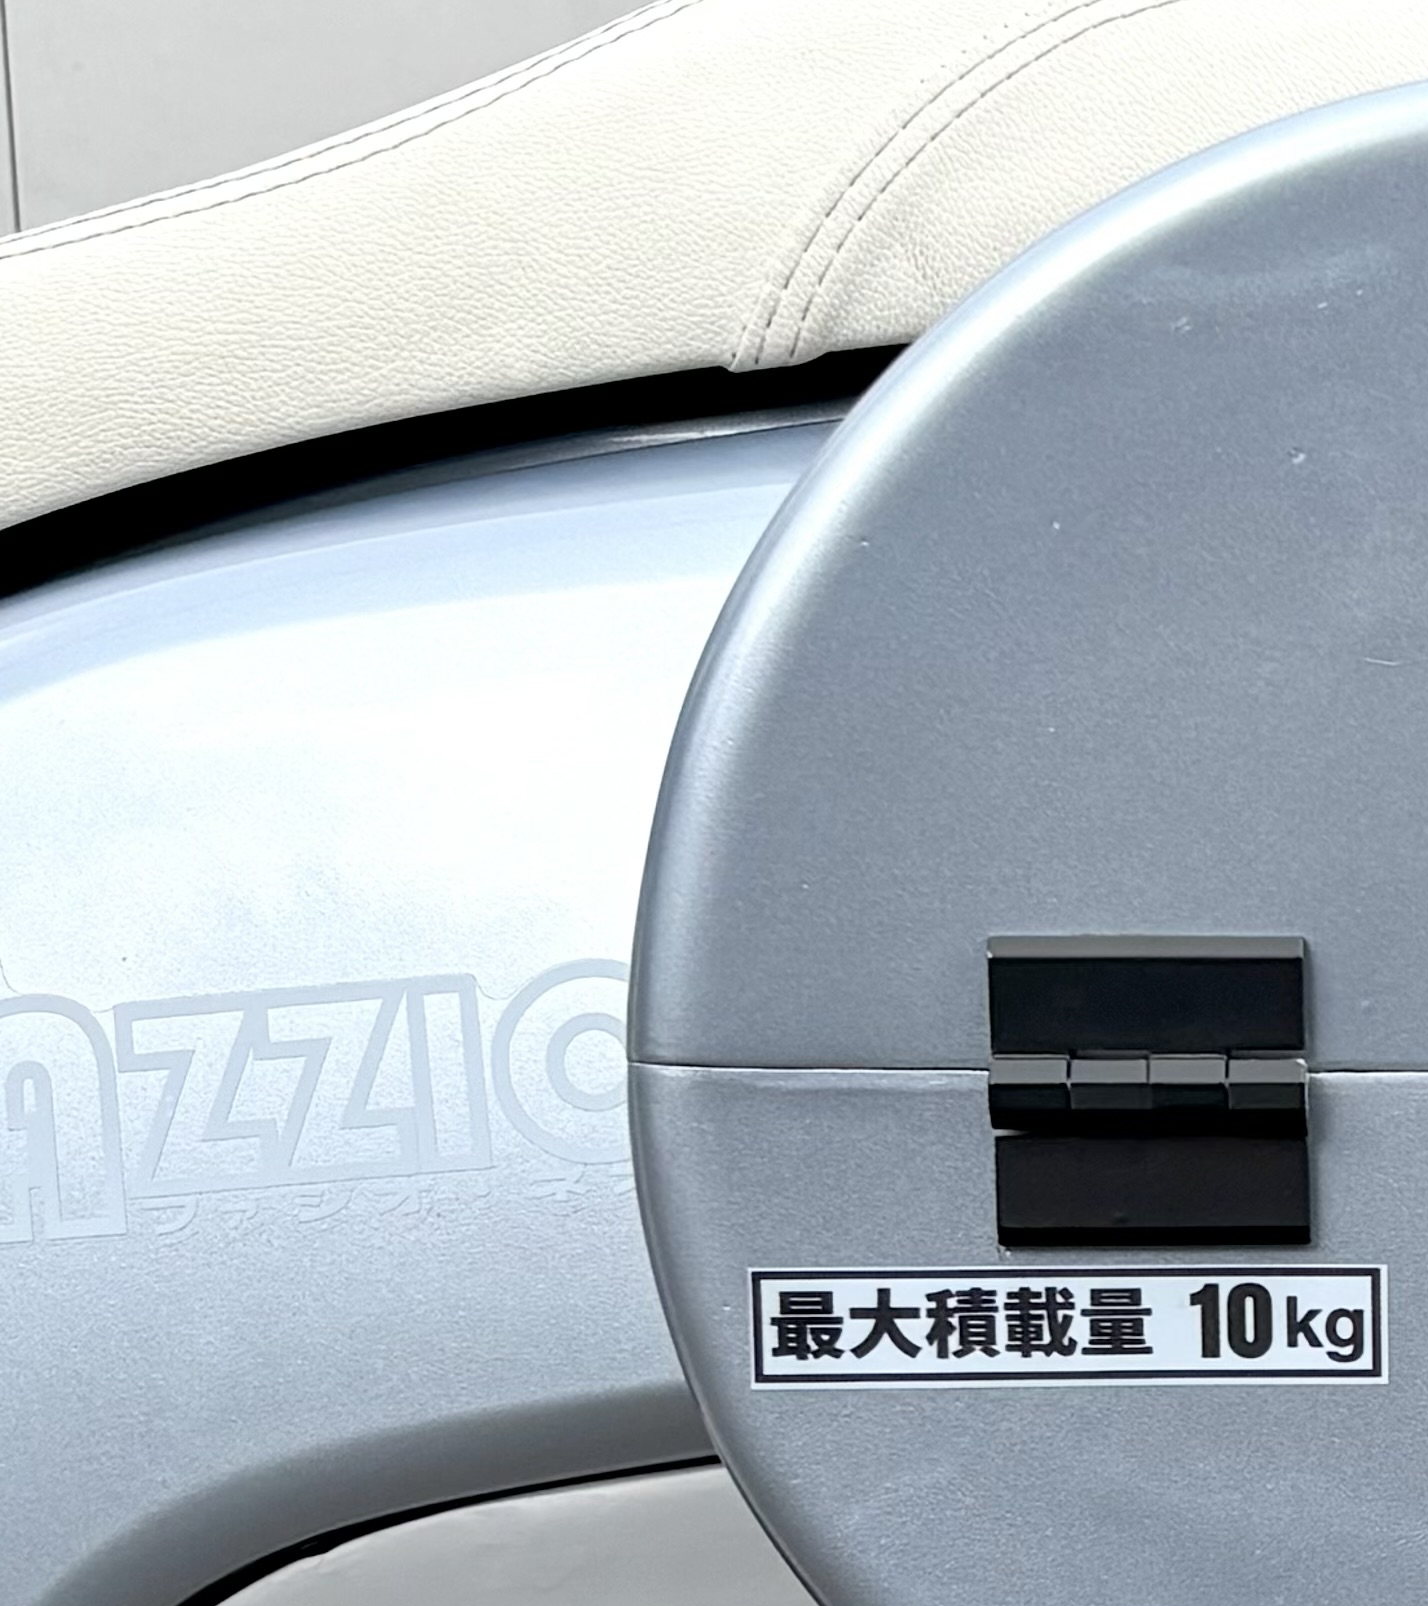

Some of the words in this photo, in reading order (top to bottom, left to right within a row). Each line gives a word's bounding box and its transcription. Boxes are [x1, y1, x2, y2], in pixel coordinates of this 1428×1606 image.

[769, 1286, 1154, 1361] 最大積載量
[1188, 1282, 1366, 1362] 10kg
